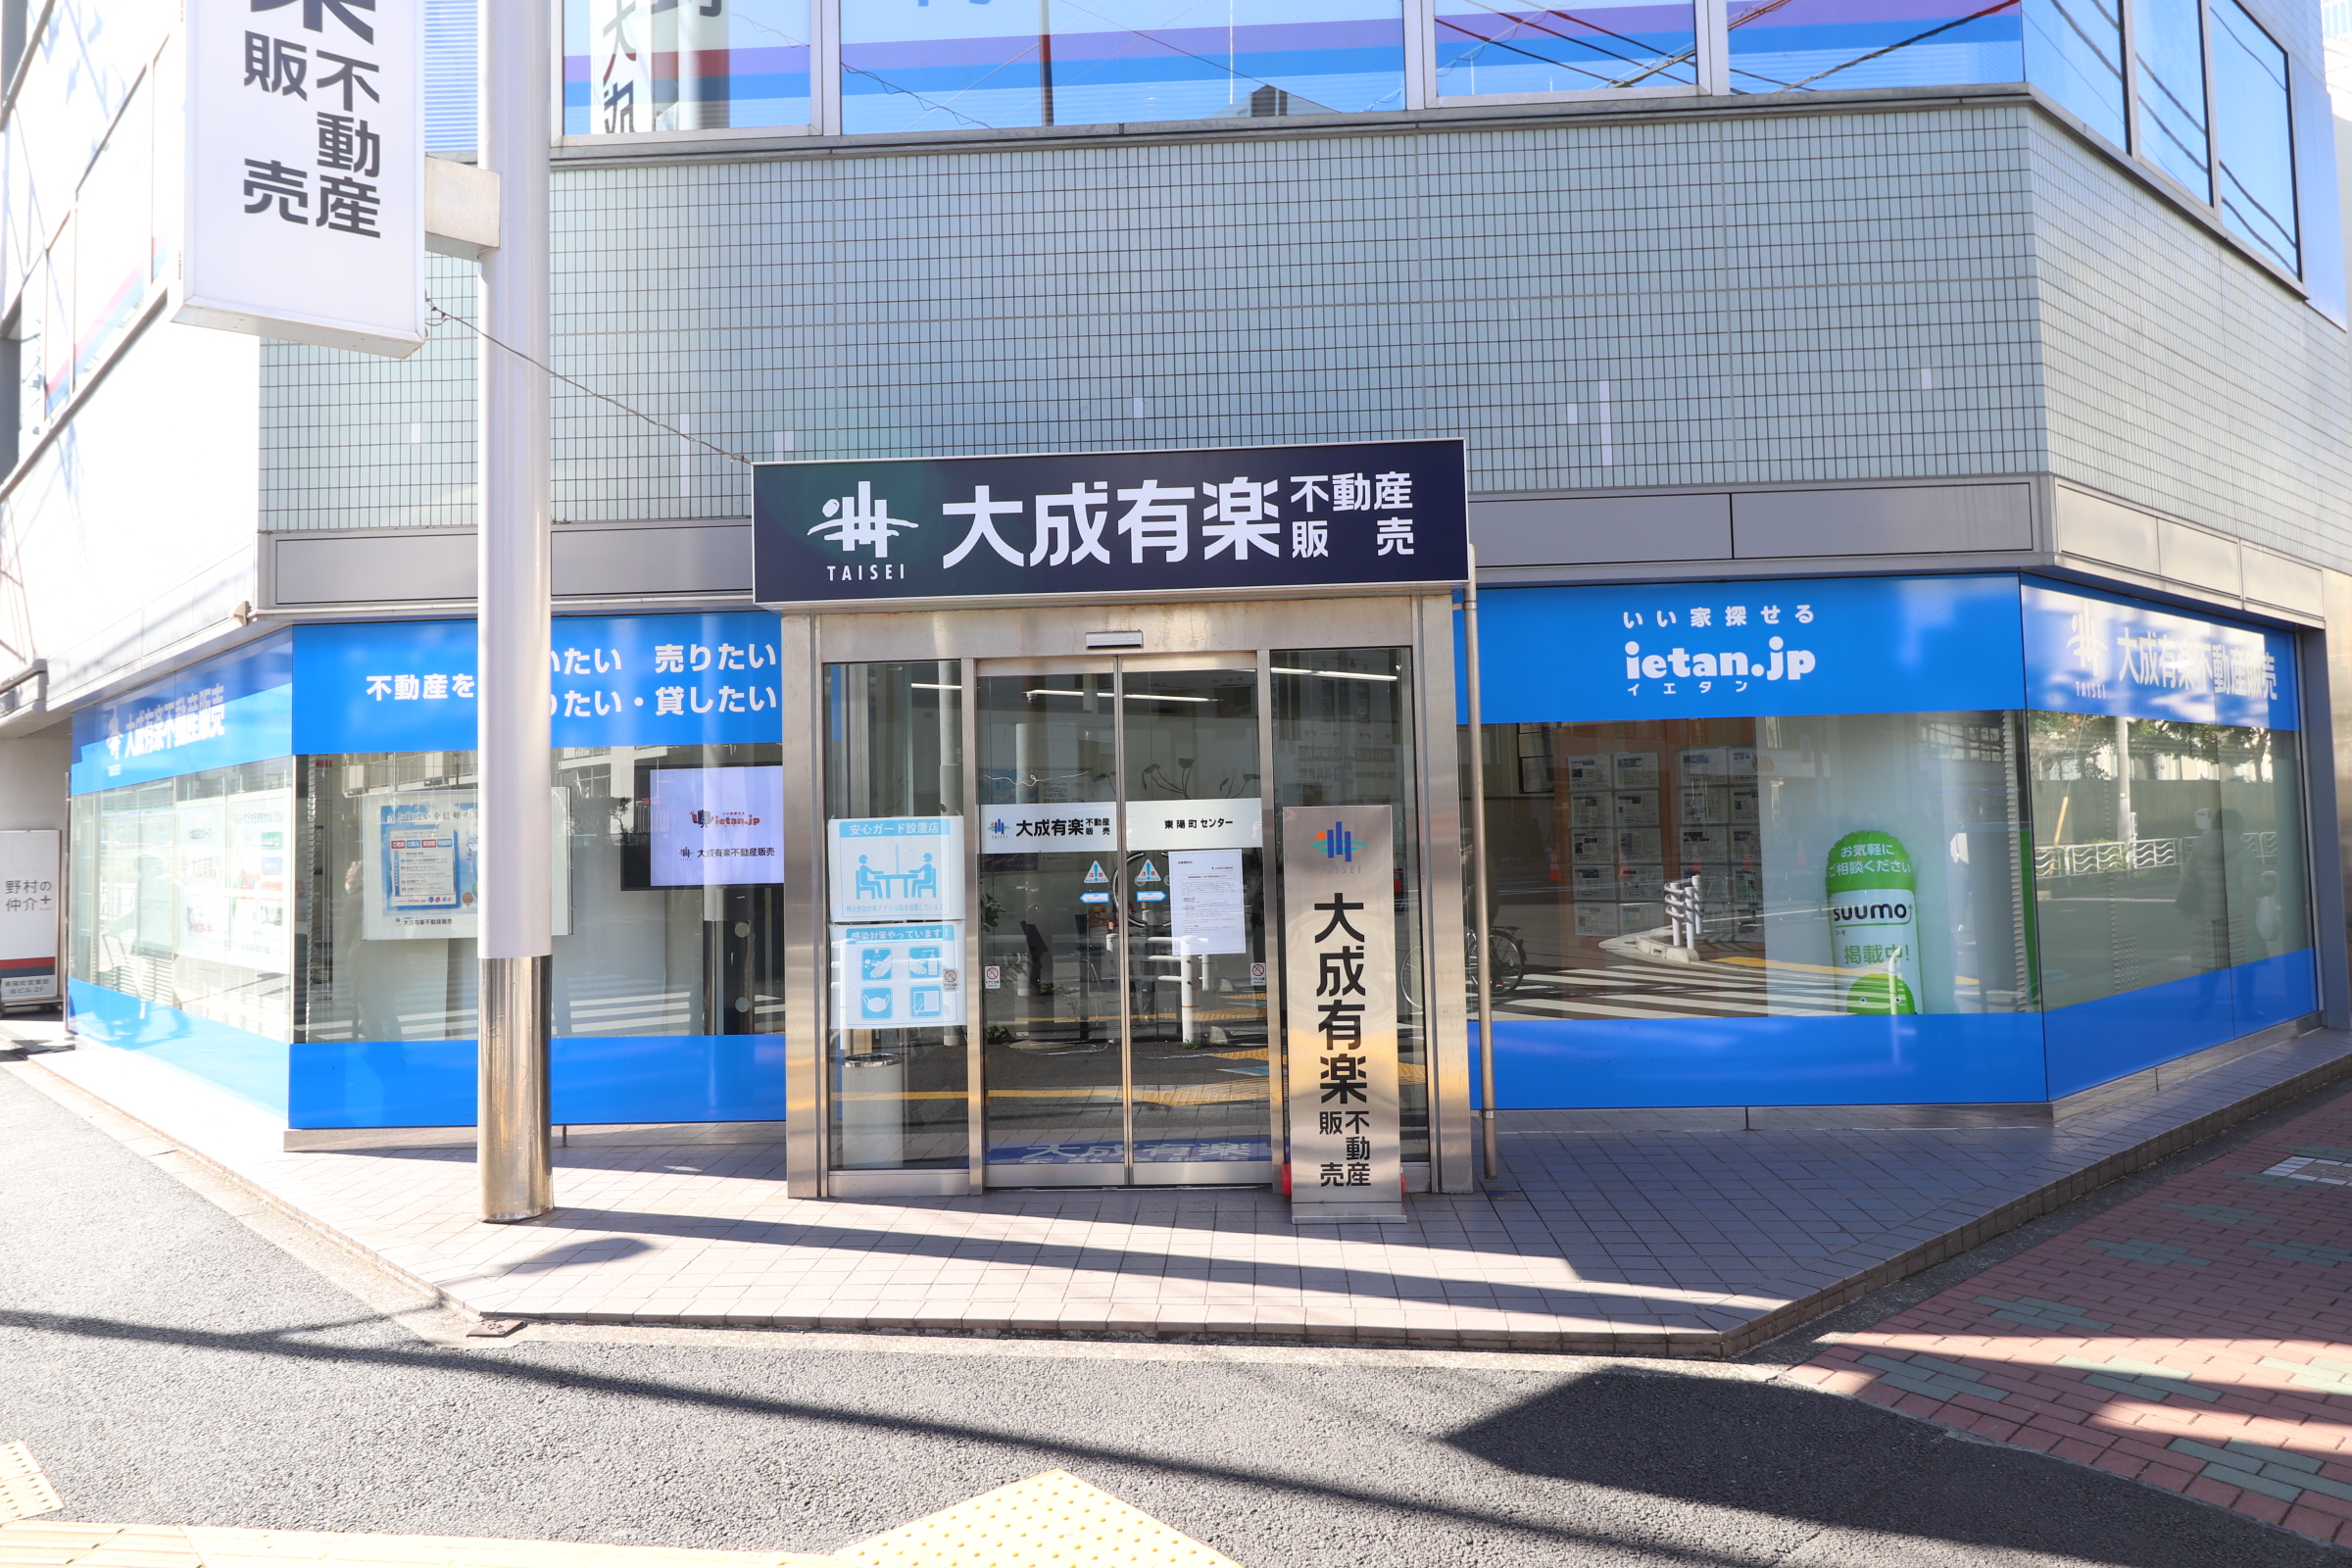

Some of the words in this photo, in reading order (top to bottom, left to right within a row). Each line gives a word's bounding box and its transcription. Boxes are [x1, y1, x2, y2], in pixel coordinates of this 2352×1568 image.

[243, 30, 308, 225] 販売
[316, 49, 380, 238] 不動産
[1290, 471, 1413, 514] 不動産
[942, 477, 1280, 568] 大成有楽
[1292, 517, 1416, 558] 販売
[826, 563, 906, 581] TAISEI
[1623, 604, 1814, 629] いい家探せる
[655, 642, 776, 674] 売りたい
[1624, 635, 1816, 681] ietan.jp
[2117, 626, 2278, 701] 大成有楽不動産販売
[366, 672, 475, 702] 不動産を
[1628, 680, 1747, 697] イエタン
[2075, 680, 2107, 700] TAISEI
[715, 814, 760, 826] ietan.jp
[849, 822, 940, 836] 安心ガード設置店
[1015, 818, 1085, 837] 大成有楽
[1085, 817, 1110, 826] 不動産
[697, 847, 775, 858] 大成有楽不動産販売
[1840, 843, 1895, 858] お気軽に
[1826, 858, 1912, 877] ご相談ください
[5, 880, 52, 894] 野村の
[1313, 892, 1368, 1104] 大成有楽
[1319, 1110, 1345, 1188] 販売
[1345, 1110, 1371, 1187] 不動産
